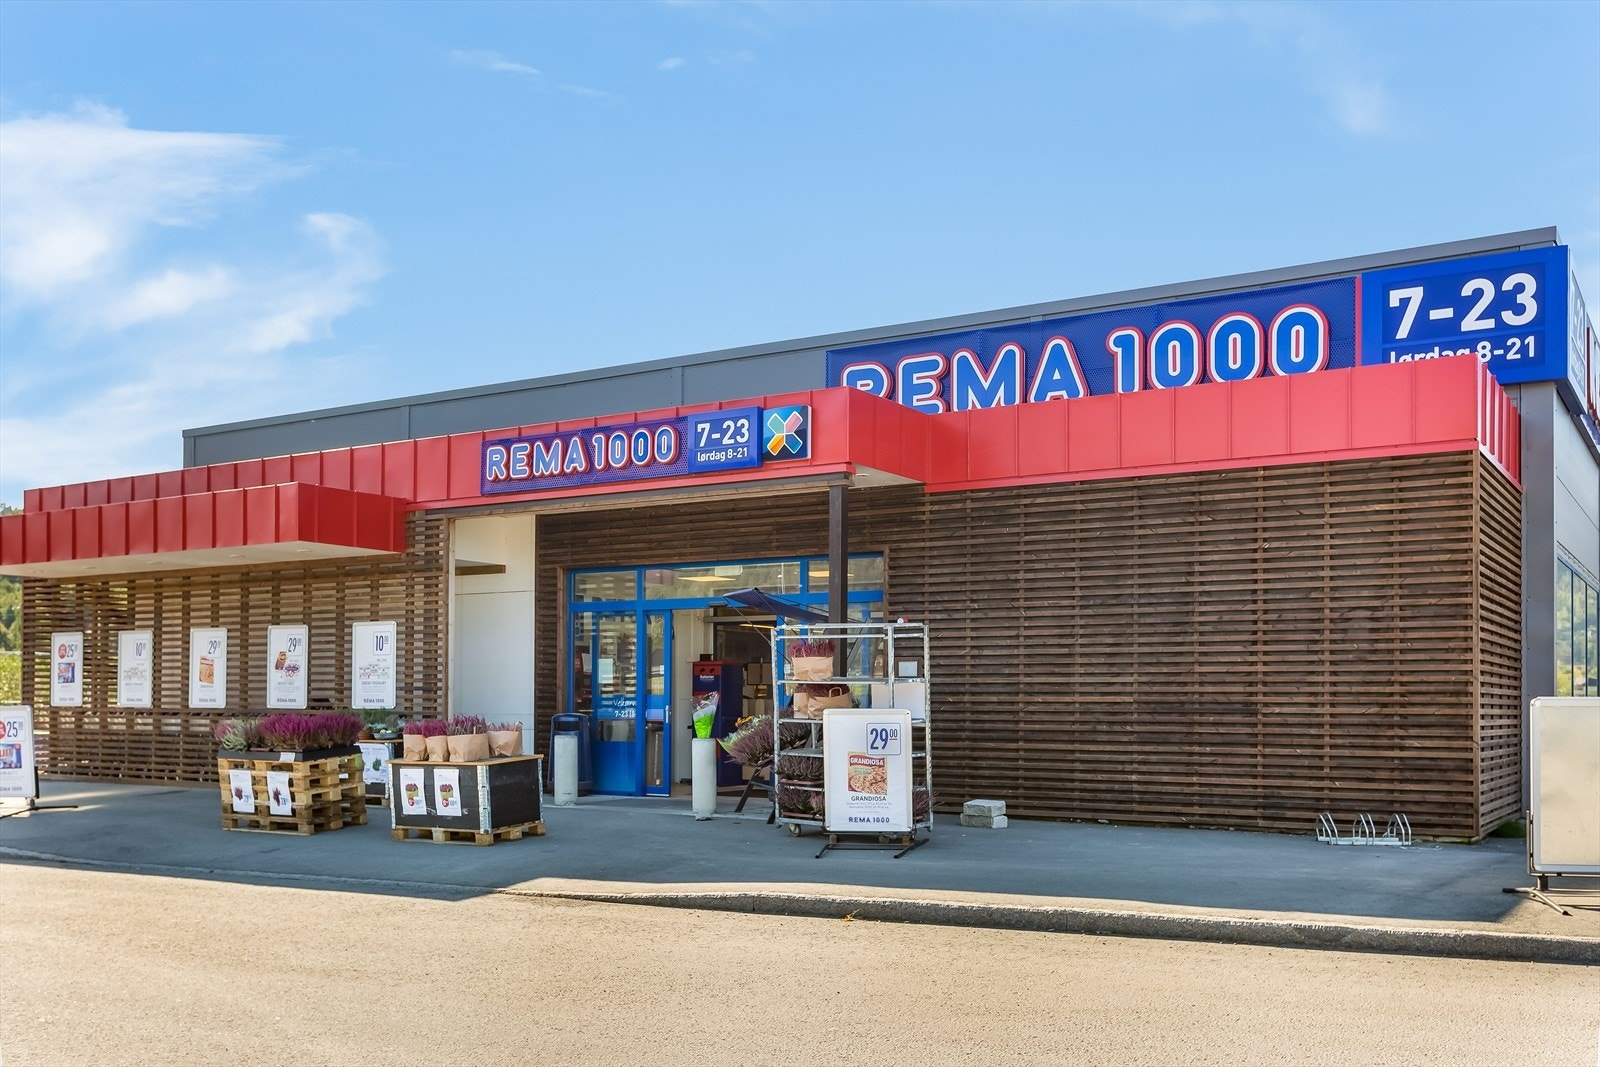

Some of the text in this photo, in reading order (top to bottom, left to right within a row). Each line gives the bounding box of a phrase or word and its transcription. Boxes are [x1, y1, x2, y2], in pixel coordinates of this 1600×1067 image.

[1389, 272, 1538, 340] 7-23
[1106, 303, 1330, 394] 1000
[1476, 335, 1535, 363] 8-21
[697, 418, 750, 447] 7-23
[486, 424, 681, 482] REMA 1000
[697, 447, 748, 462] lørdag 8-21
[208, 640, 218, 655] 29
[288, 637, 297, 653] 29
[375, 635, 384, 652] 10
[6, 720, 18, 738] 25
[870, 728, 898, 750] 29 00
[851, 757, 885, 766] GRANDIOSA
